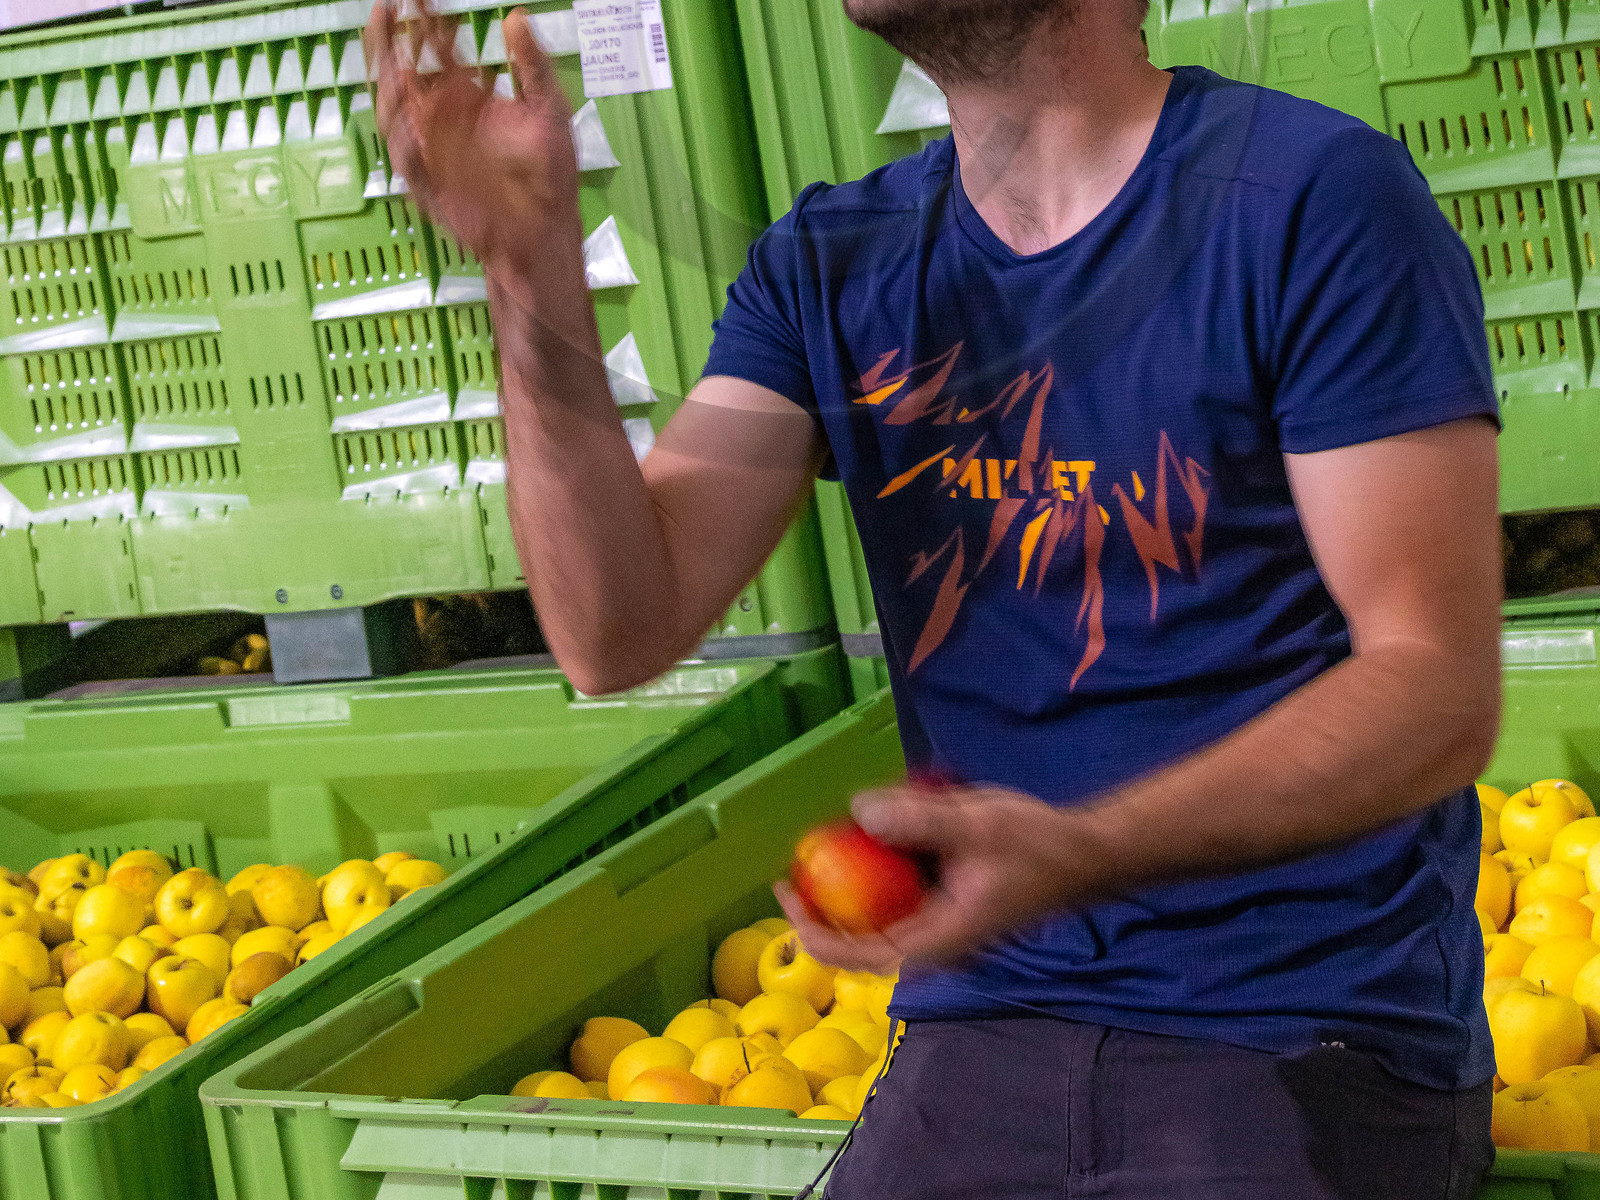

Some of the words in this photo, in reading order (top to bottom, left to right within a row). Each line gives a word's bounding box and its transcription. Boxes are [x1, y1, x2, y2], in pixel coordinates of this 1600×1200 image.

[582, 52, 620, 67] JAUNE
[1201, 10, 1424, 85] MEGY
[158, 156, 328, 224] MEGY
